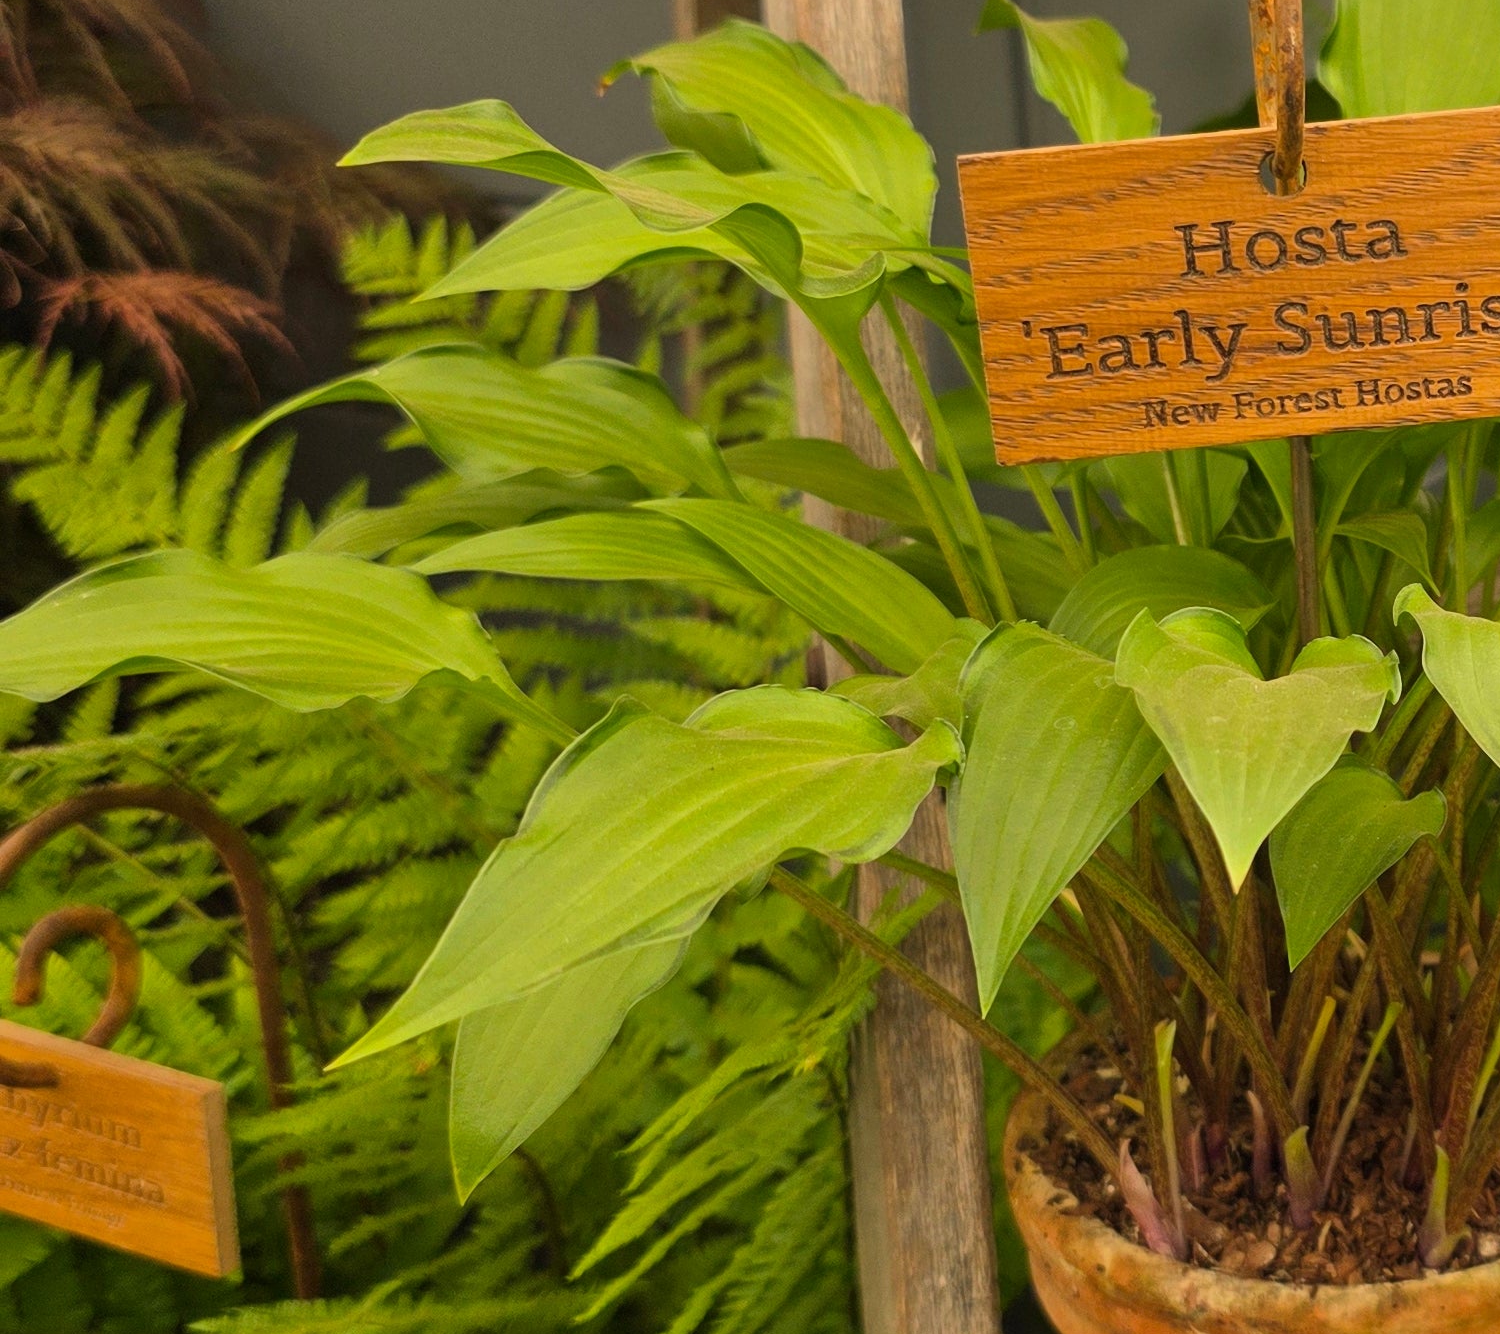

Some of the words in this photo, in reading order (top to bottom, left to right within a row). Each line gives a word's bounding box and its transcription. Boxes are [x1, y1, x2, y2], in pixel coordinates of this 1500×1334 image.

[1175, 217, 1408, 278] Hosta
[1021, 308, 1248, 384] 'Early
[1141, 398, 1221, 429] New
[1232, 387, 1342, 420] Forest
[1355, 374, 1473, 408] Hostas
